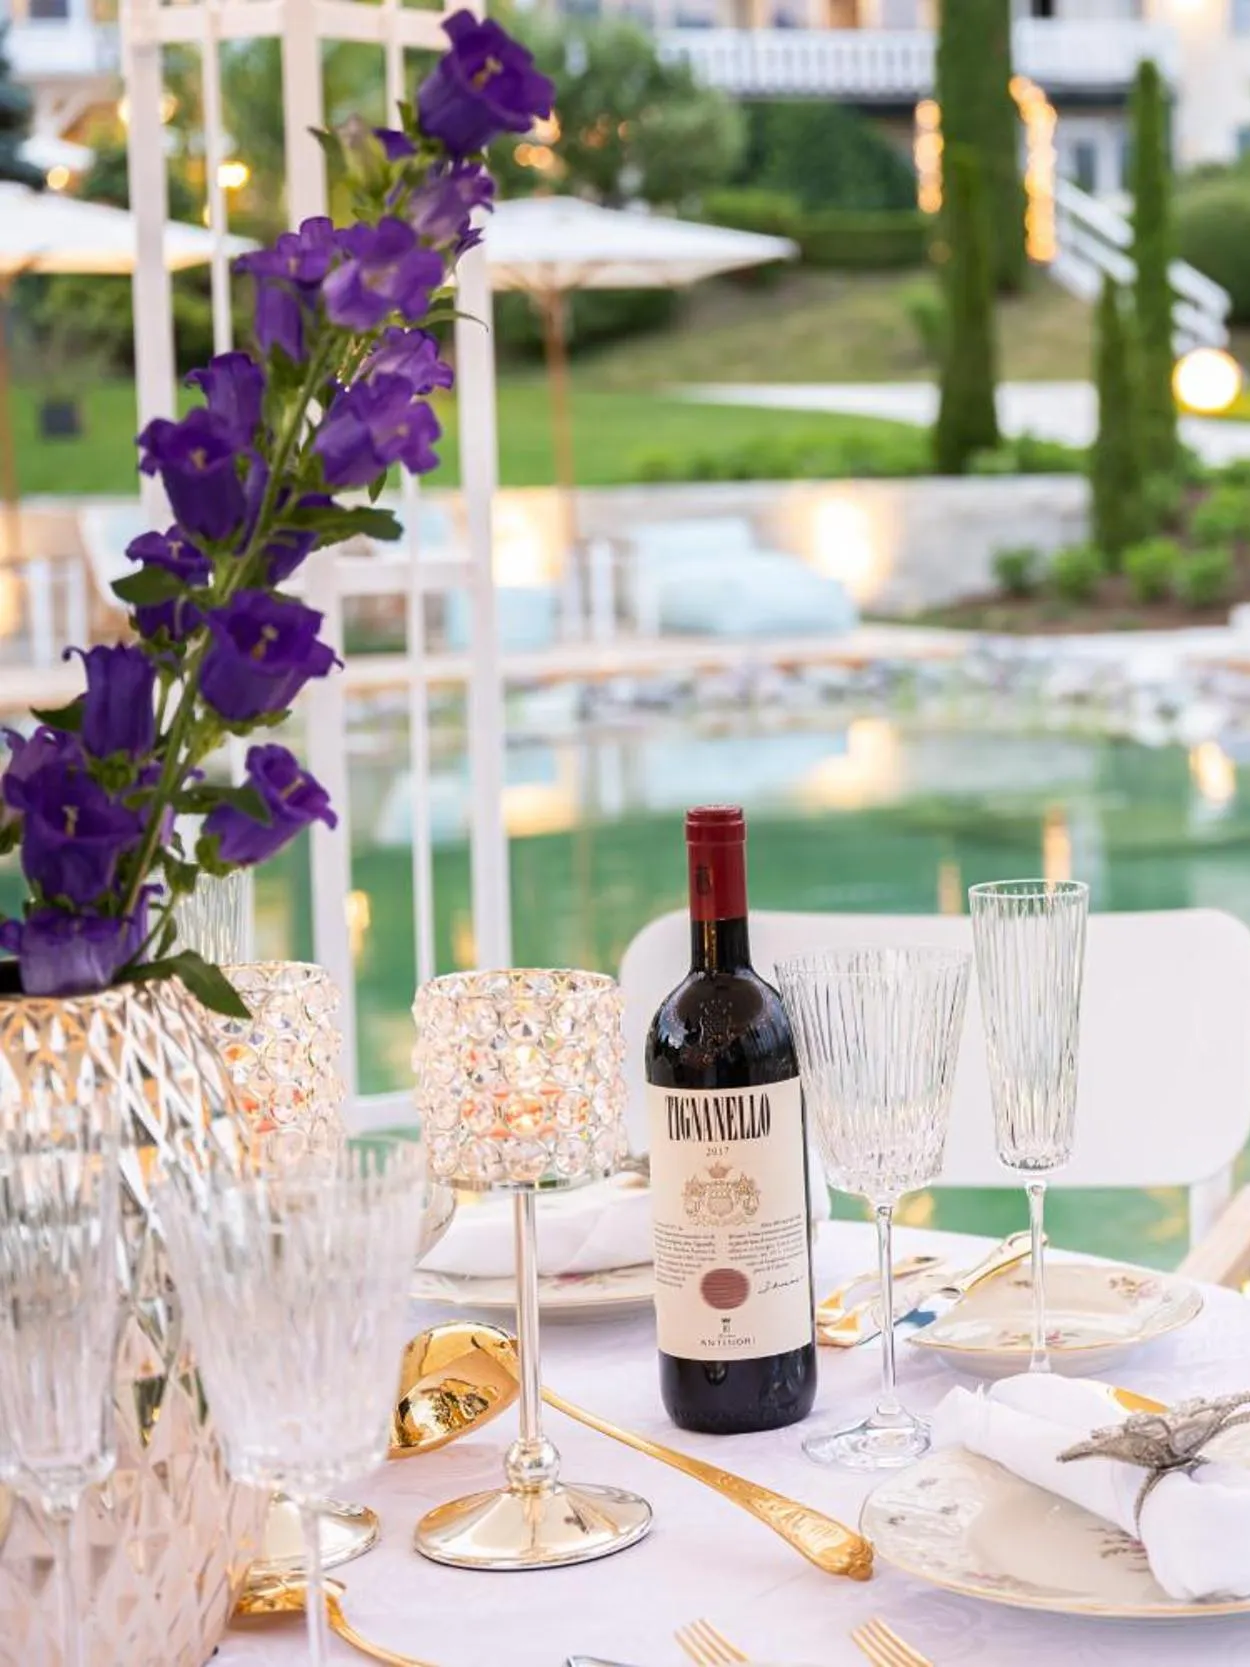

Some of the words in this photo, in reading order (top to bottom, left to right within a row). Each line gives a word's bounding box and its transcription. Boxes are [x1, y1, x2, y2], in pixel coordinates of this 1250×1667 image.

[665, 1093, 771, 1142] TIGNANELLO
[706, 1147, 729, 1157] 2017
[701, 1336, 755, 1347] ANTINORI
